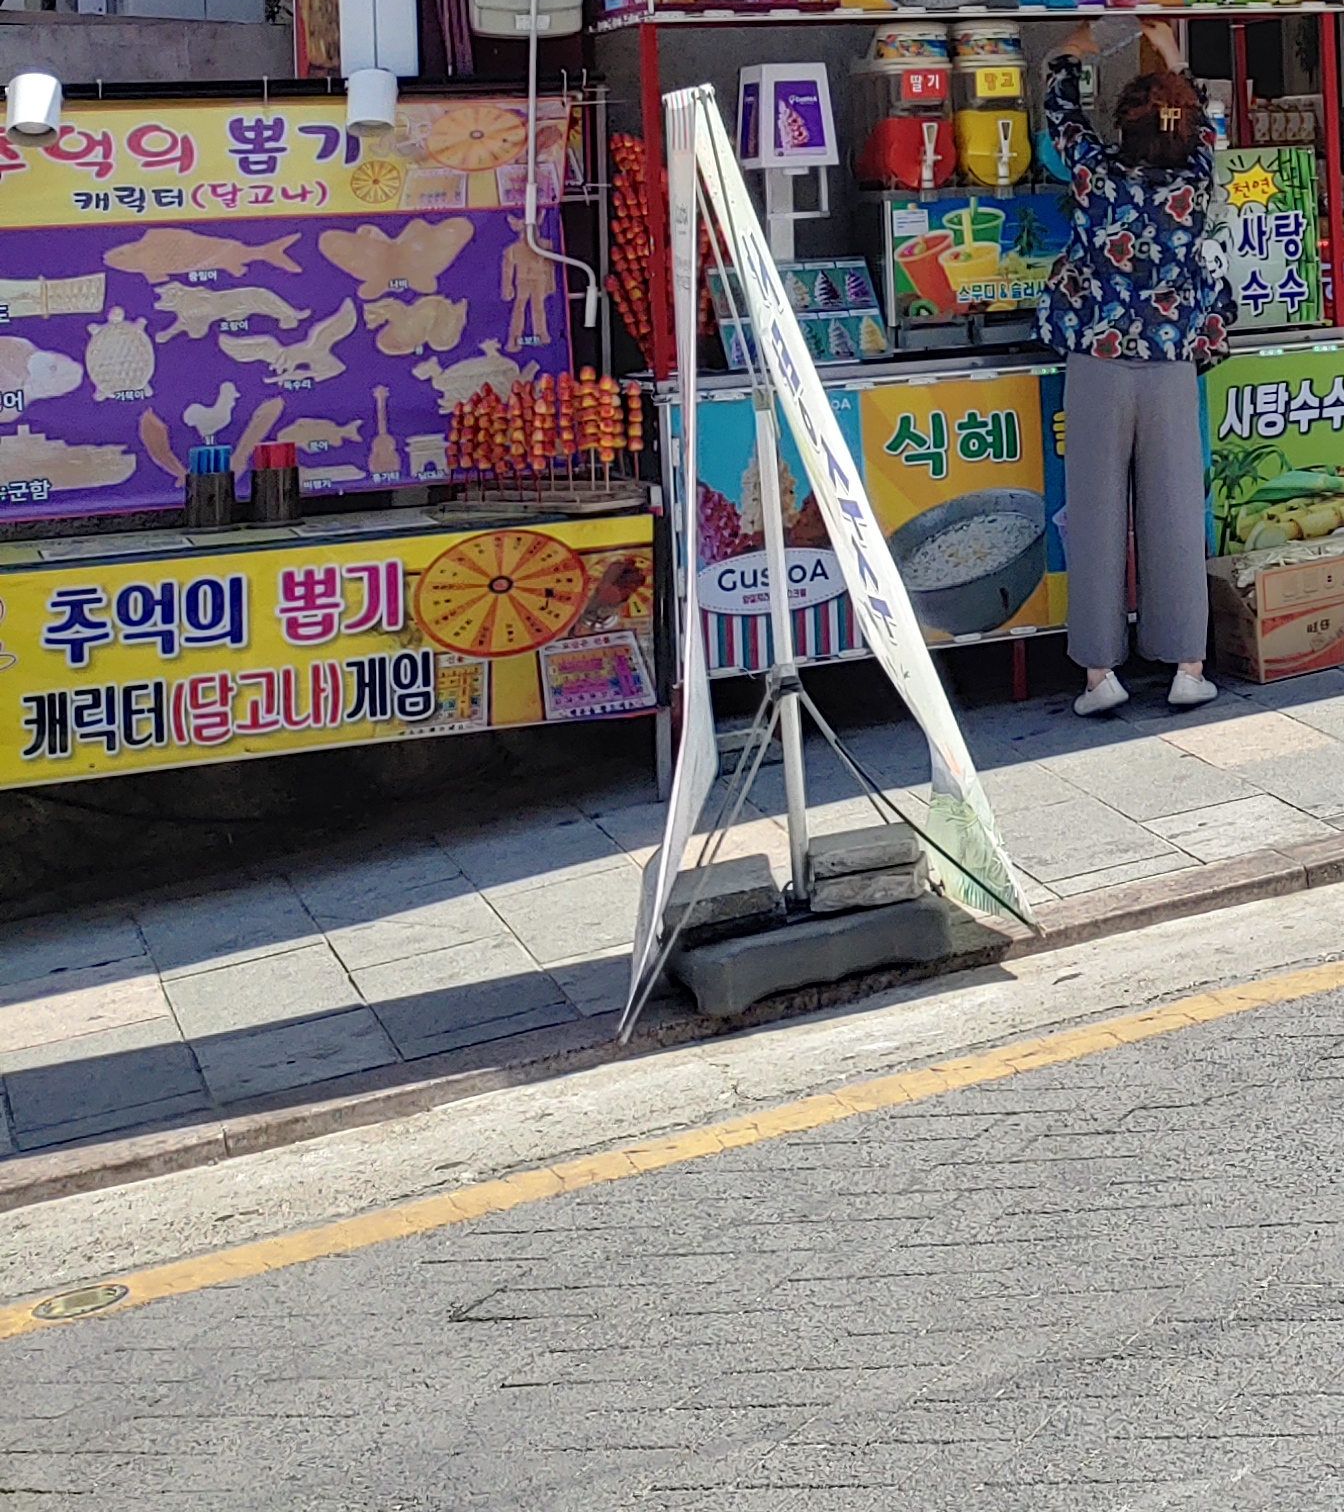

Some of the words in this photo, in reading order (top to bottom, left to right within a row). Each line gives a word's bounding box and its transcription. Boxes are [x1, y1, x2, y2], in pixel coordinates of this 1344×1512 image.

[910, 74, 941, 93] 딸기
[0, 124, 195, 178] 억의
[228, 117, 361, 175] 뽑기
[73, 180, 329, 213] 캐릭터(달고나)
[1232, 176, 1271, 198] 천연
[957, 281, 996, 303] 스무디
[1240, 268, 1308, 314] 수수
[886, 409, 1020, 478] 식혜
[0, 479, 50, 501] 군함
[718, 559, 829, 592] GusoA
[43, 575, 246, 664] 추억의
[278, 560, 406, 642] 뽑기
[22, 651, 435, 760] 캐릭터(달고나)게임
